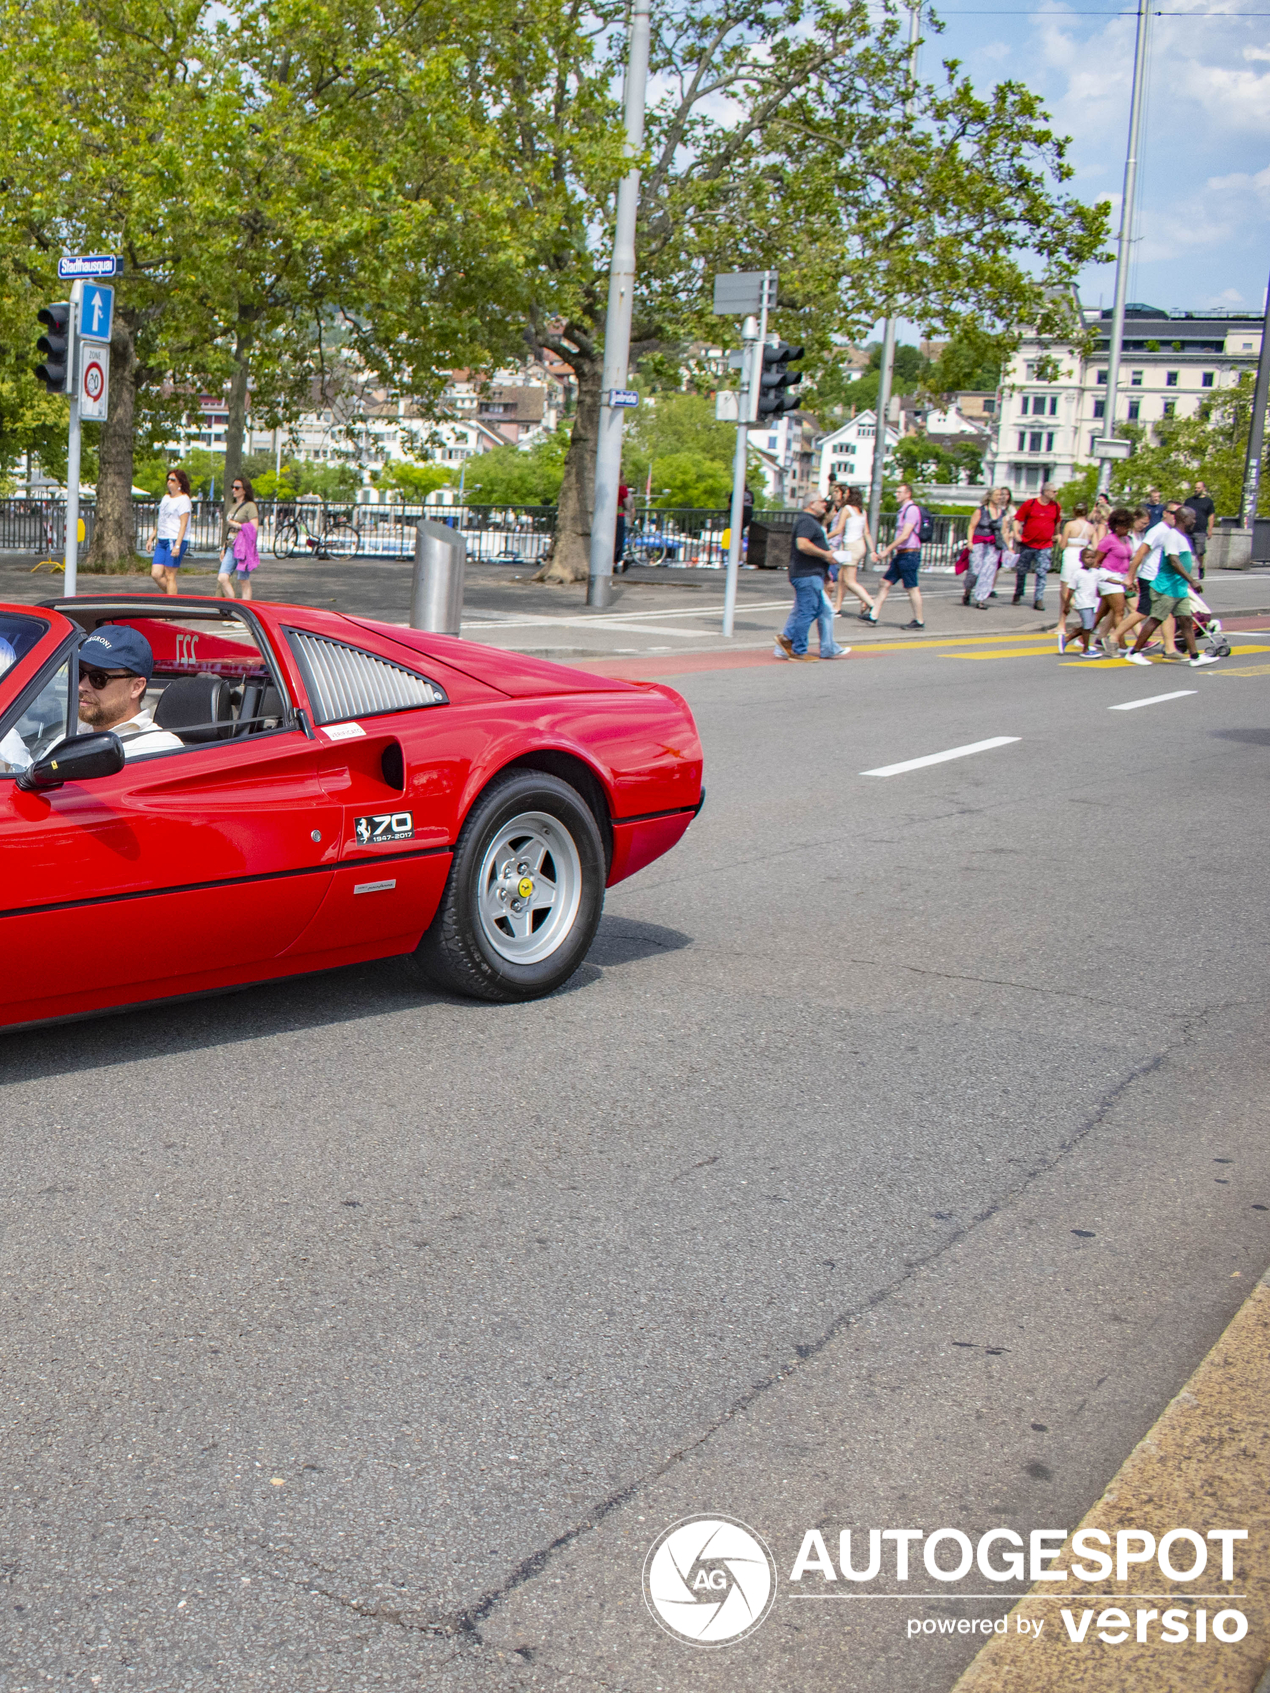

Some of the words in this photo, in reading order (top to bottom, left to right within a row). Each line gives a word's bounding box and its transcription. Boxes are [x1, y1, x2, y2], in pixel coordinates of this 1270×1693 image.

[89, 350, 102, 360] ZONE
[372, 812, 412, 835] 70
[373, 831, 412, 842] 1947-2017
